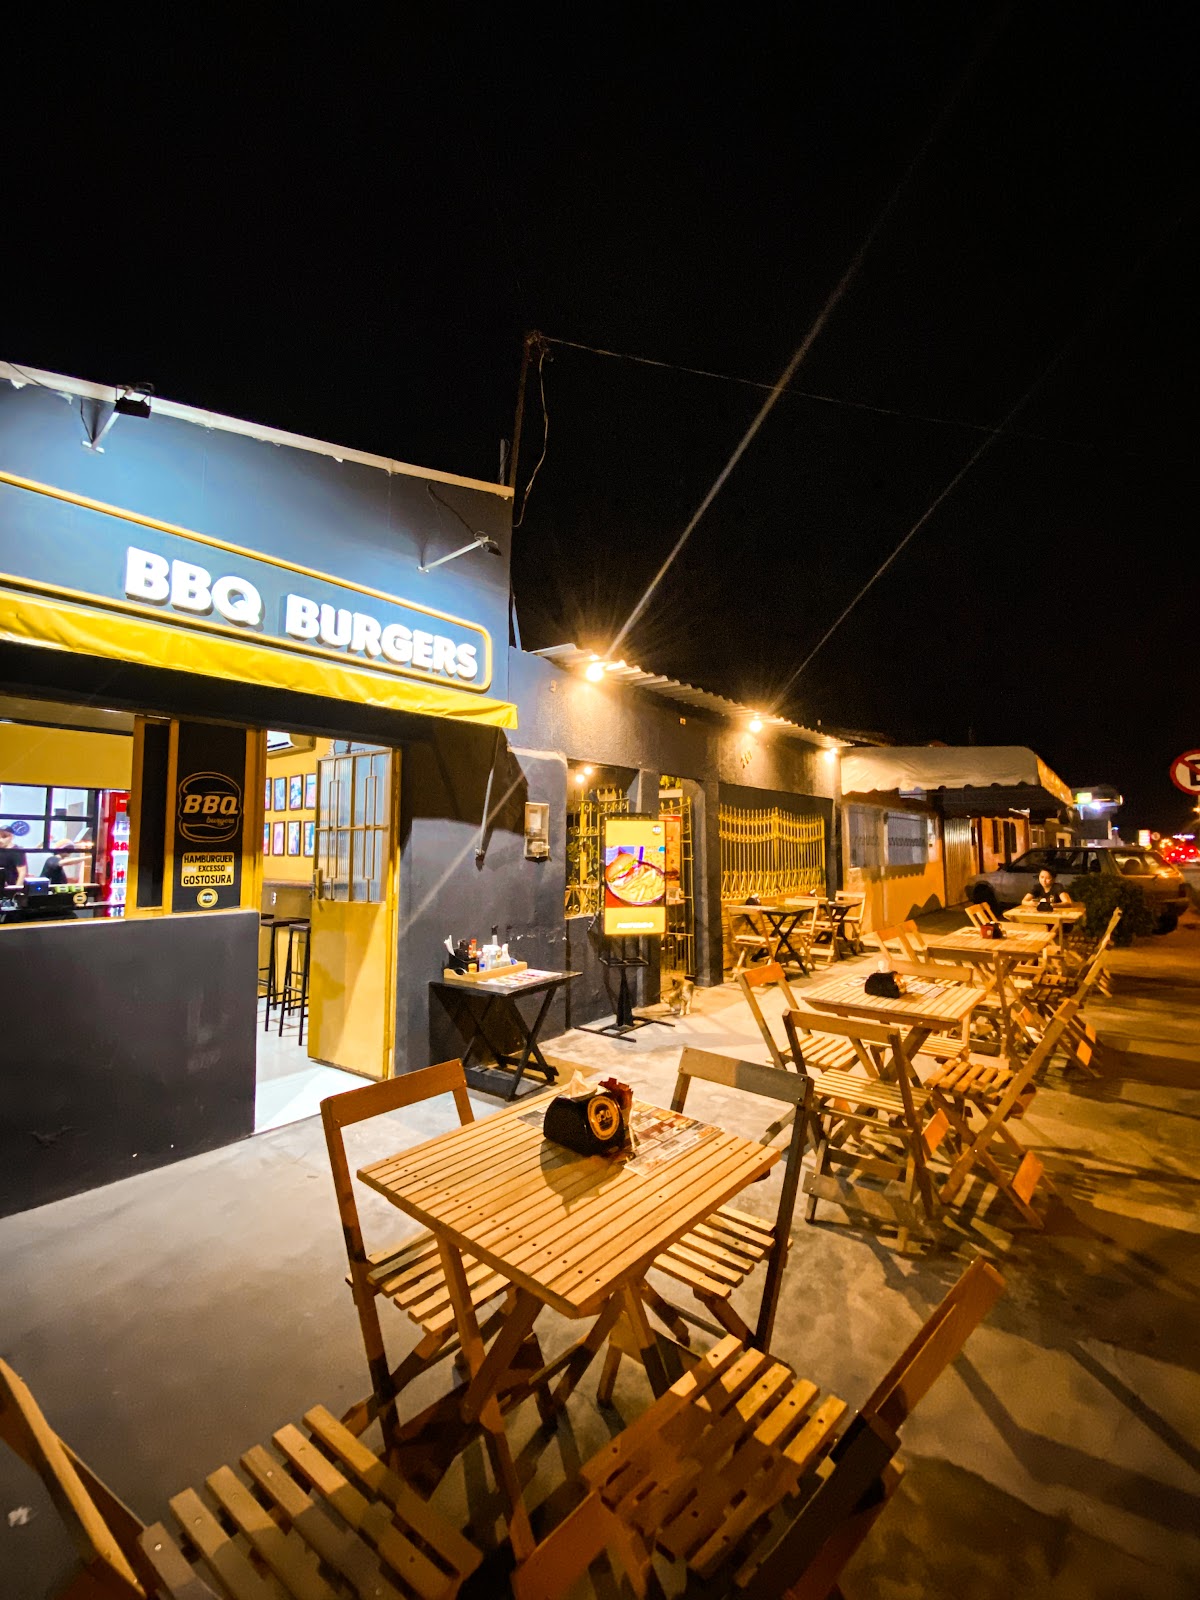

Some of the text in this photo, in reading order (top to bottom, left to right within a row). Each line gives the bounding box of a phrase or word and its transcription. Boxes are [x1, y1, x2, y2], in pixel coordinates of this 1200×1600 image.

[125, 546, 477, 679] BBQ BURGERS
[183, 794, 238, 815] BBQ
[184, 854, 233, 864] HAMBURGUER
[198, 864, 225, 872] EXCESSO
[183, 874, 232, 885] GOSTOSURA
